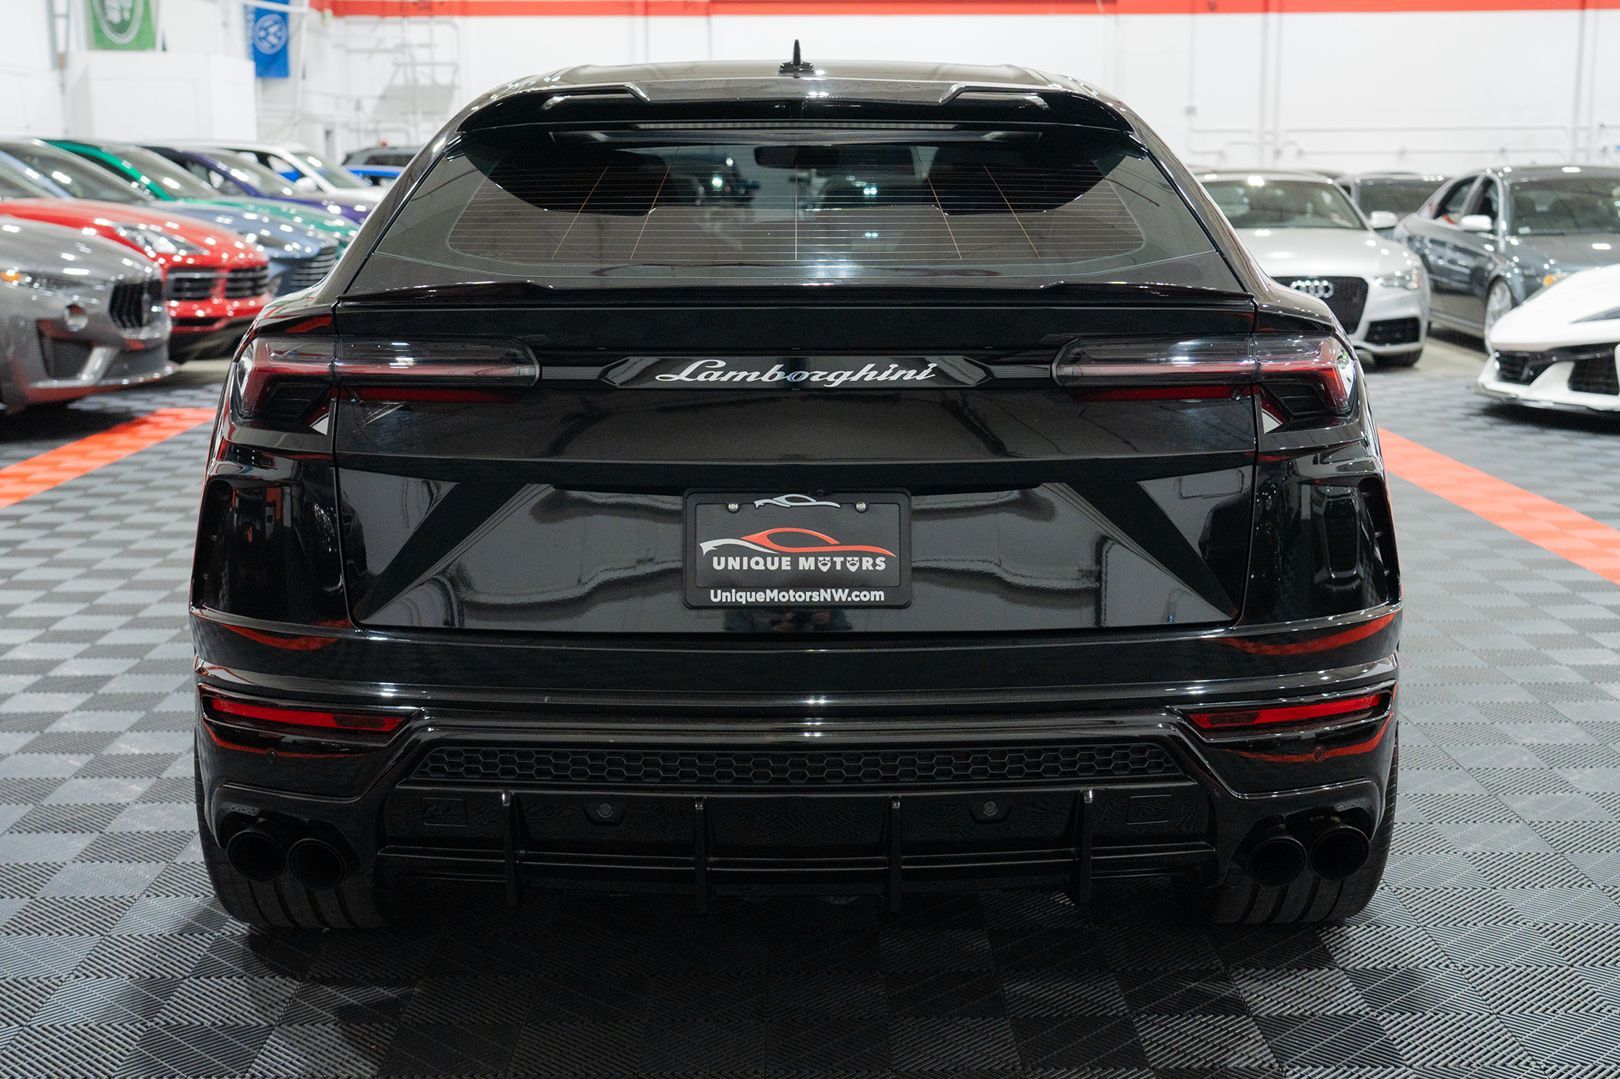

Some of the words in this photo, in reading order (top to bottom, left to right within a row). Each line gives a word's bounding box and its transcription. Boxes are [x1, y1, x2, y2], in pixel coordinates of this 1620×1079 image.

[655, 359, 937, 388] Lamborghini
[712, 556, 792, 571] UNIQUE
[798, 556, 887, 572] MOTORS
[710, 588, 885, 604] UniqueMotorsNW.com
